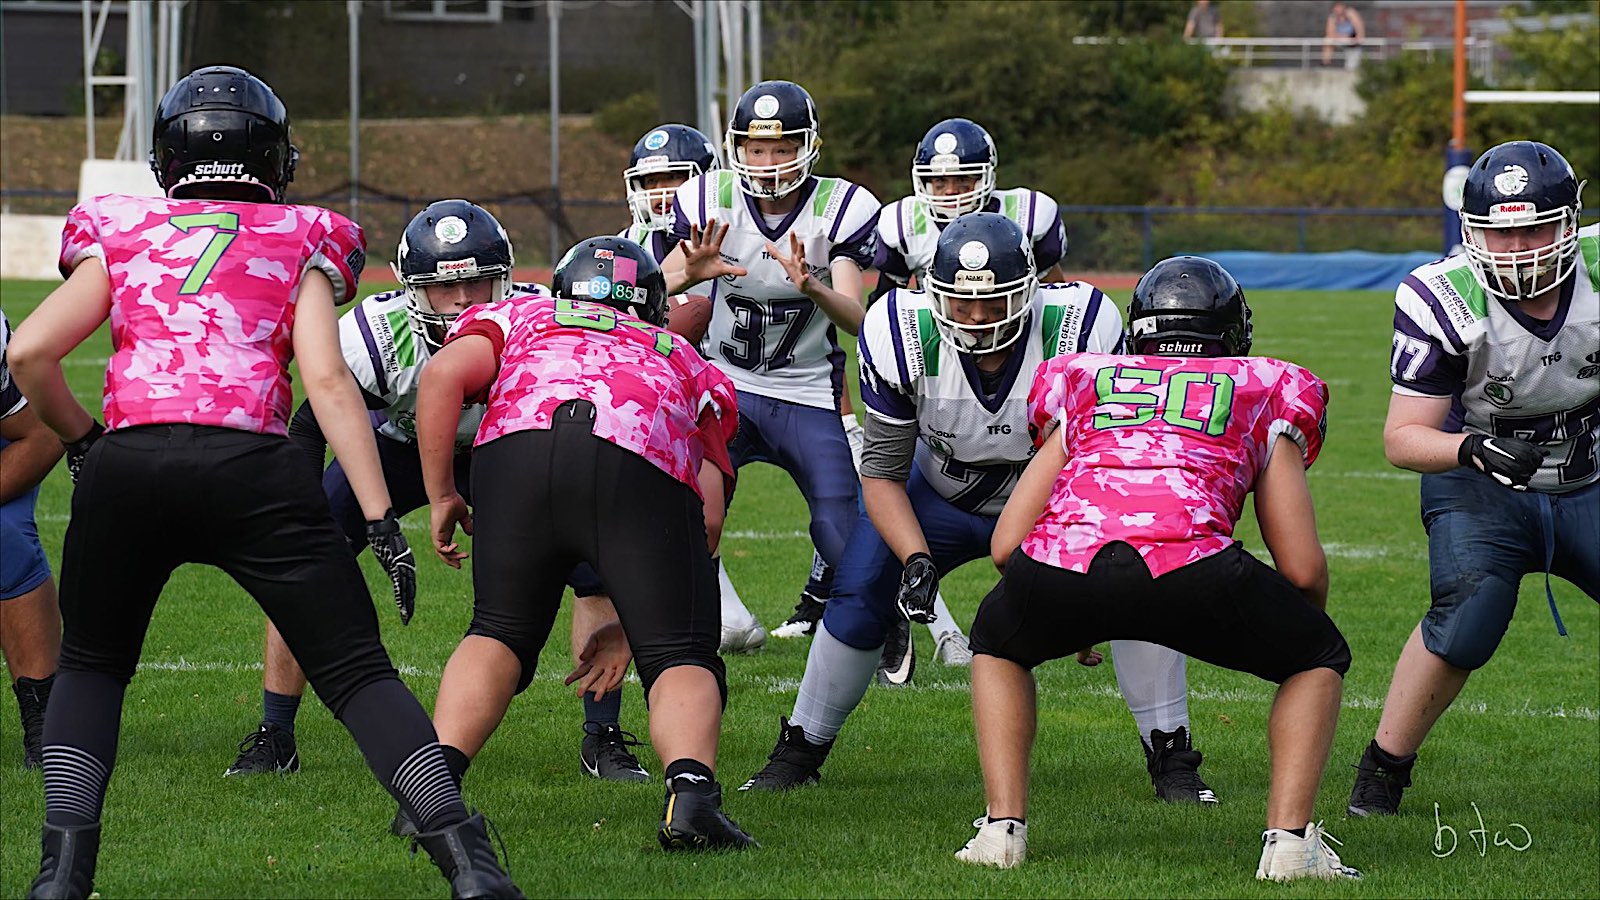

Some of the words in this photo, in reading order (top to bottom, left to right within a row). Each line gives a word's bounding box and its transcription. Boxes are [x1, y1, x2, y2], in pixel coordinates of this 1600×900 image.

[194, 160, 244, 175] schutt
[1500, 204, 1525, 212] Riddell
[168, 211, 239, 296] 7
[445, 261, 468, 270] Riddell
[591, 280, 610, 295] 69
[616, 284, 634, 299] 85
[378, 313, 393, 341] BRANCO
[907, 309, 918, 339] BRANCO
[1061, 304, 1076, 340] GEMMER
[1066, 307, 1081, 355] ROTECHNIK
[720, 293, 818, 374] 37
[1159, 340, 1203, 353] schutt
[1389, 330, 1431, 383] 77
[1541, 351, 1562, 367] TFG
[1093, 366, 1235, 438] 50
[987, 424, 1012, 435] TFG
